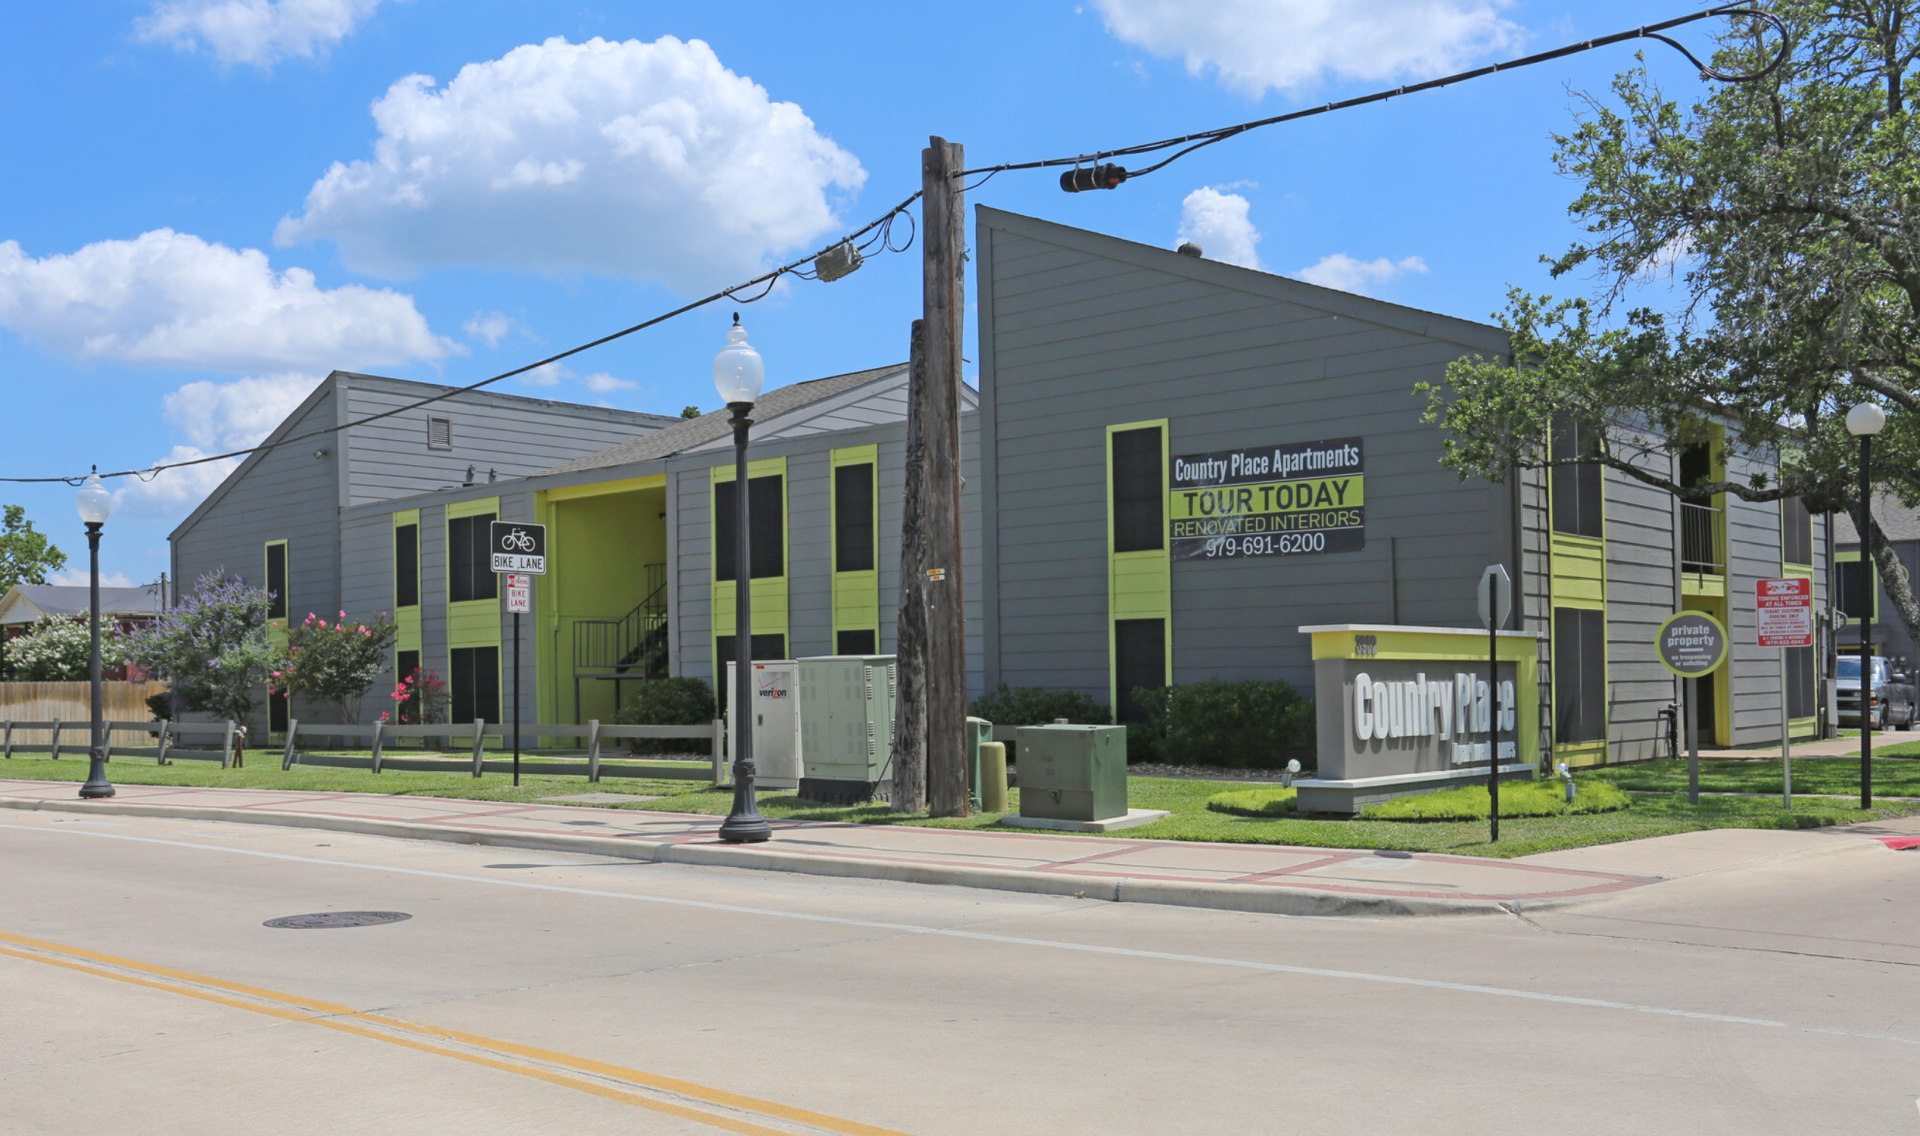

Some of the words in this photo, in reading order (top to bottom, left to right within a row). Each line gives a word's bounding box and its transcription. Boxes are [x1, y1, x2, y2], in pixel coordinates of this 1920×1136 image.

[1175, 458, 1228, 483] Country
[1231, 453, 1269, 477] Place
[1273, 444, 1359, 477] Apartments
[1183, 488, 1253, 517] TOUR
[1259, 479, 1350, 511] TODAY
[1174, 516, 1266, 537] RENOVATED
[1270, 510, 1361, 531] INTERIORS
[1206, 532, 1325, 557] 979-691-6200
[494, 555, 514, 568] BIKE
[520, 558, 543, 570] LANE
[511, 589, 526, 598] BIKE
[511, 599, 526, 607] LANE
[1671, 624, 1710, 637] private
[1668, 635, 1714, 648] property
[759, 687, 787, 698] verizon
[1354, 672, 1454, 741] Country
